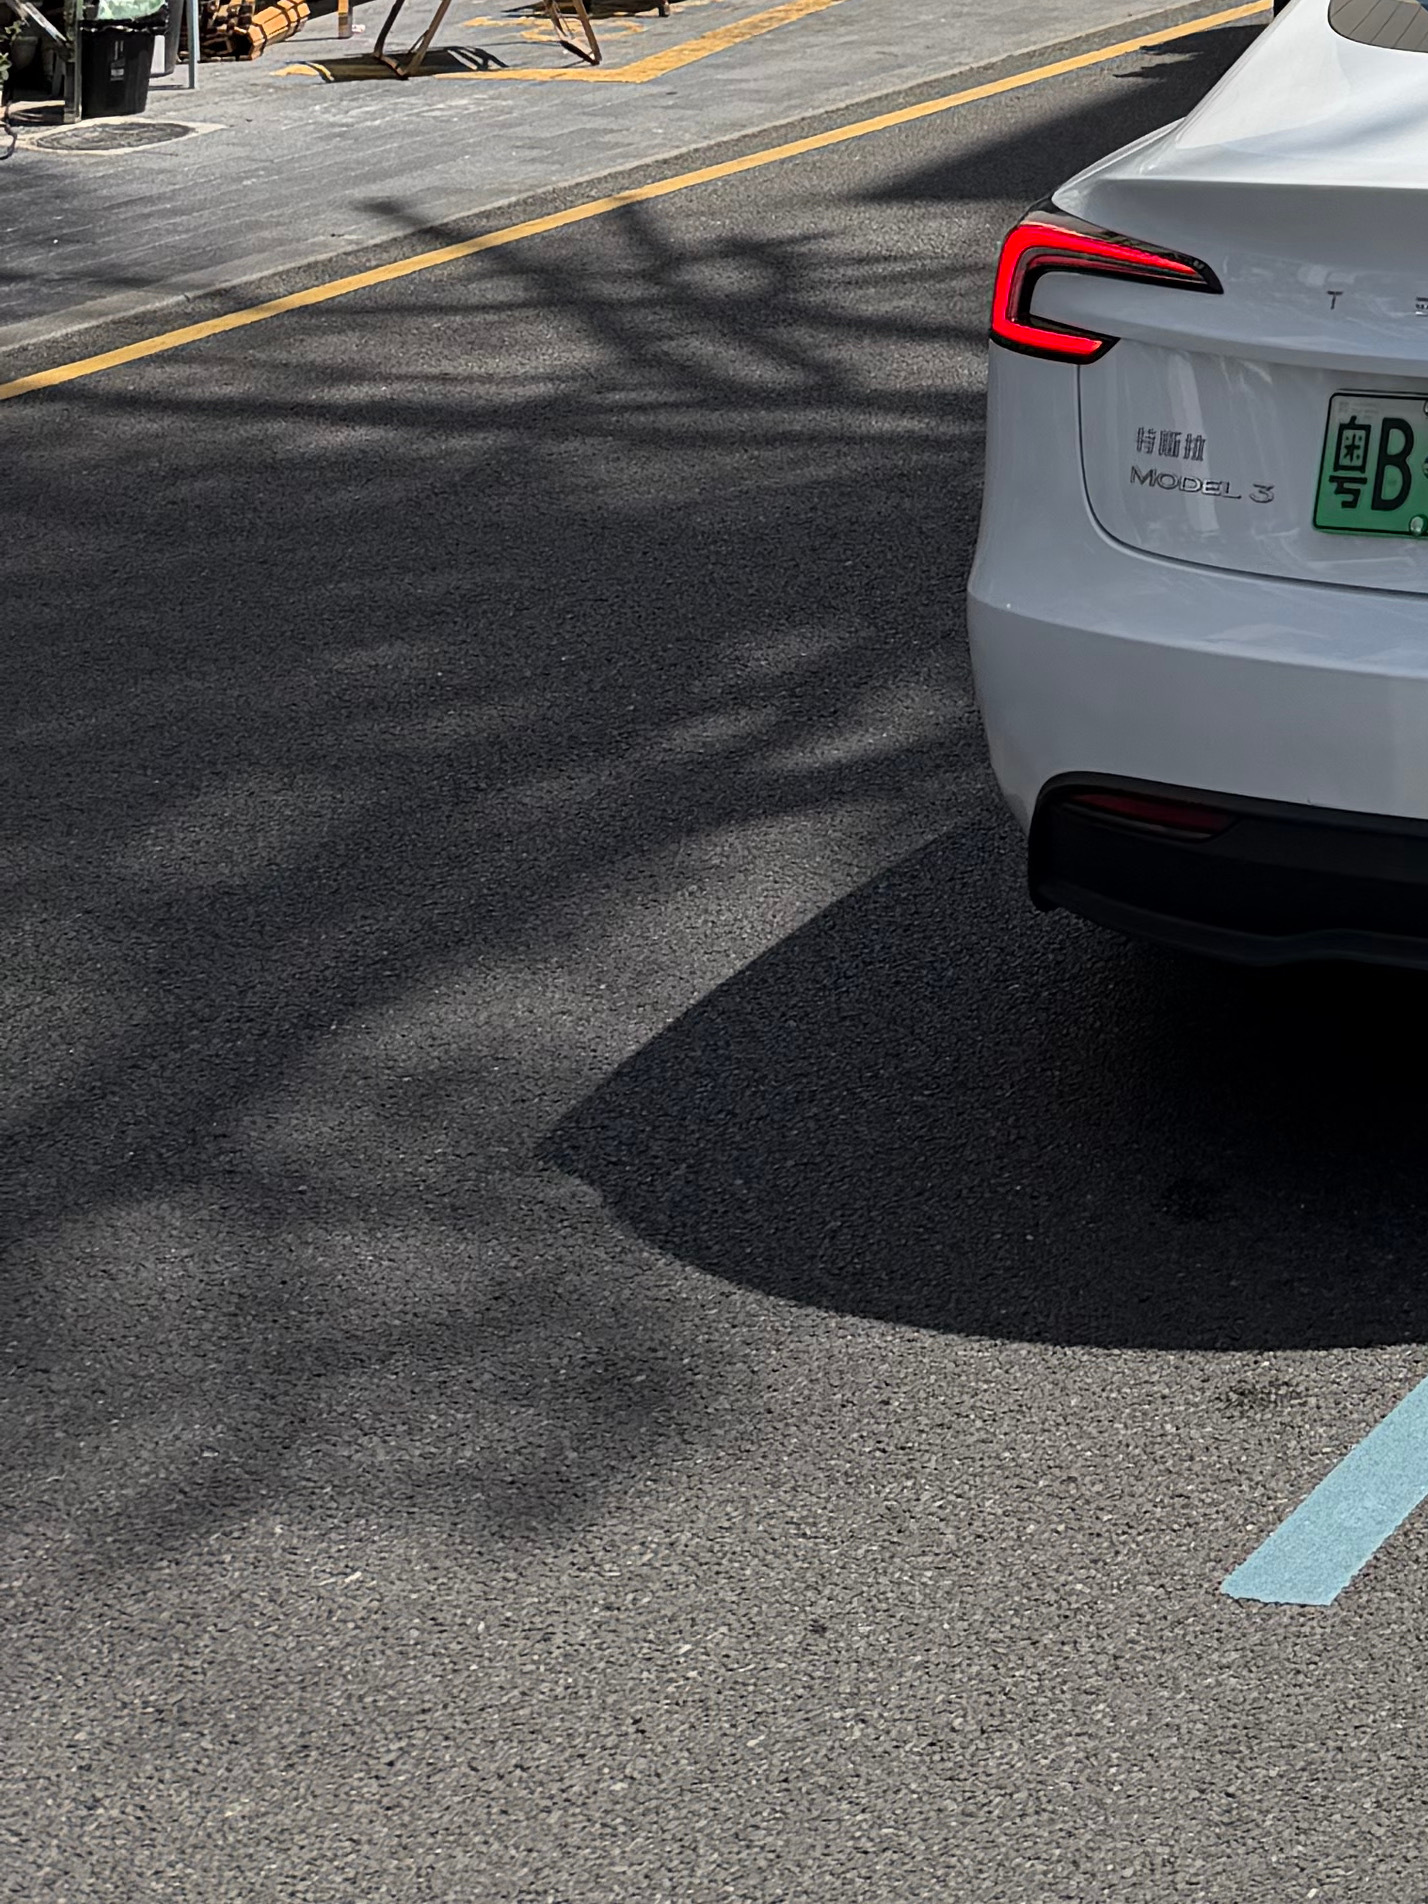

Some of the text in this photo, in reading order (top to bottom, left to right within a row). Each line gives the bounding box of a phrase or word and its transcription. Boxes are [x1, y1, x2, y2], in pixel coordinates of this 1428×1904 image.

[1135, 425, 1207, 462] 特斯拉
[1130, 464, 1276, 504] MODEL 3
